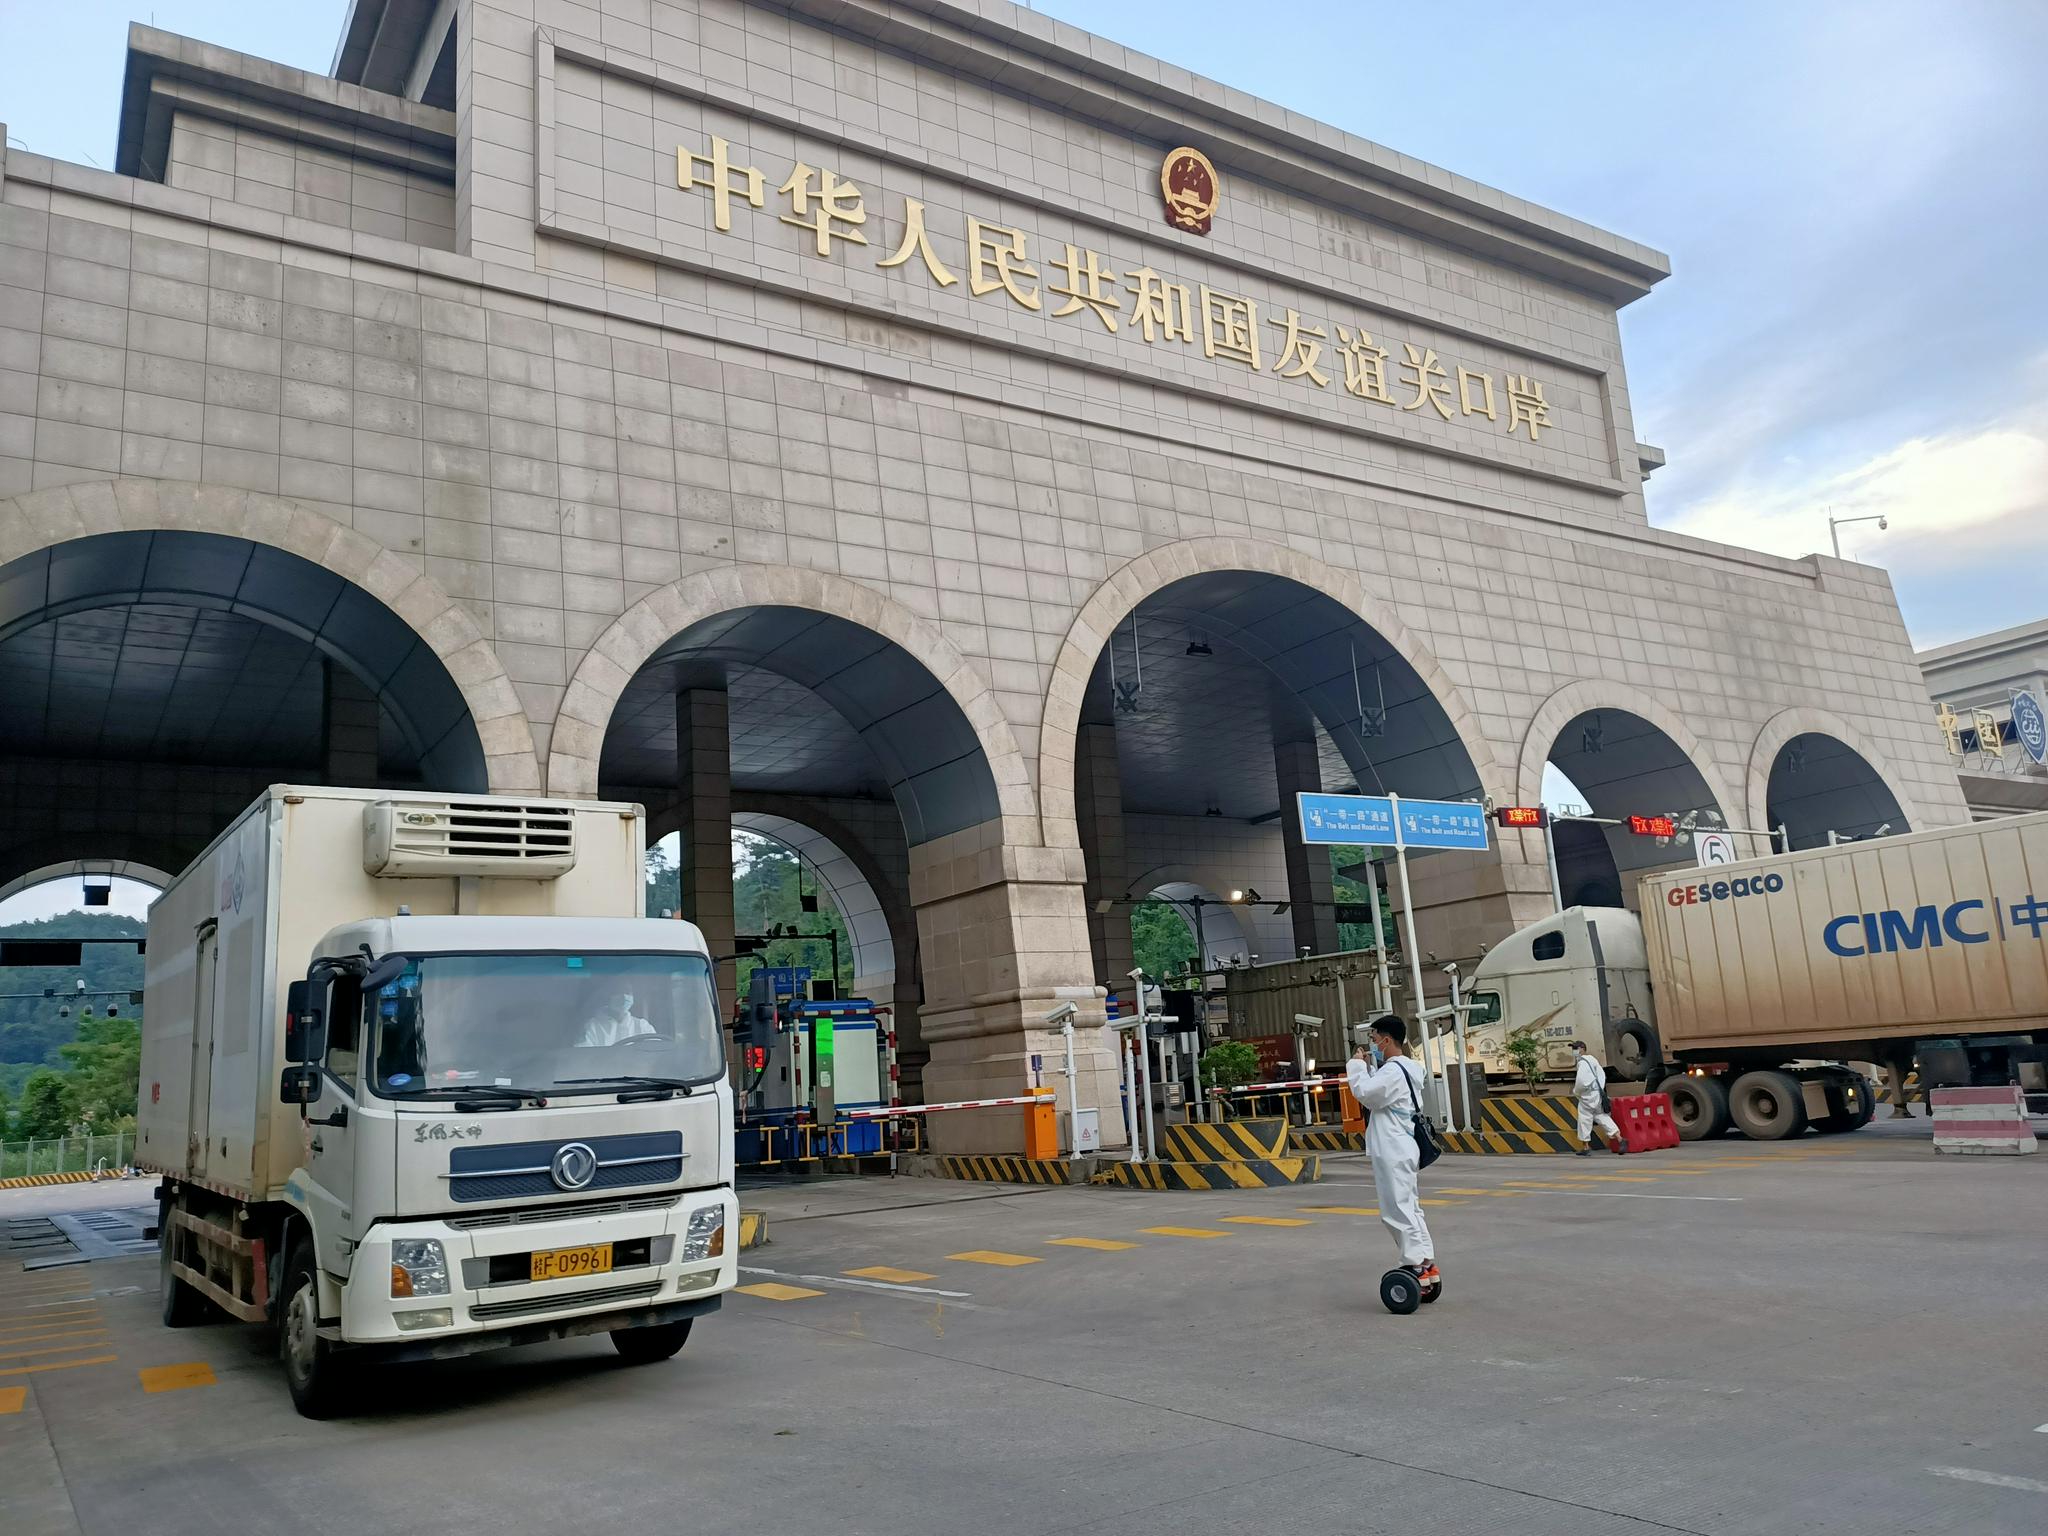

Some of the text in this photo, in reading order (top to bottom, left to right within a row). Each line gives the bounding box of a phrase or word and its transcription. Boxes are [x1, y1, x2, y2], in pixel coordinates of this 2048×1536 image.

[677, 134, 1553, 441] 中华人民共和国友谊关口岸
[1325, 822, 1337, 830] The
[1420, 826, 1431, 834] The
[1709, 841, 1725, 864] 5
[1667, 873, 1783, 907] GEseaco
[1823, 899, 1990, 957] CIMC
[2009, 894, 2048, 938] 中
